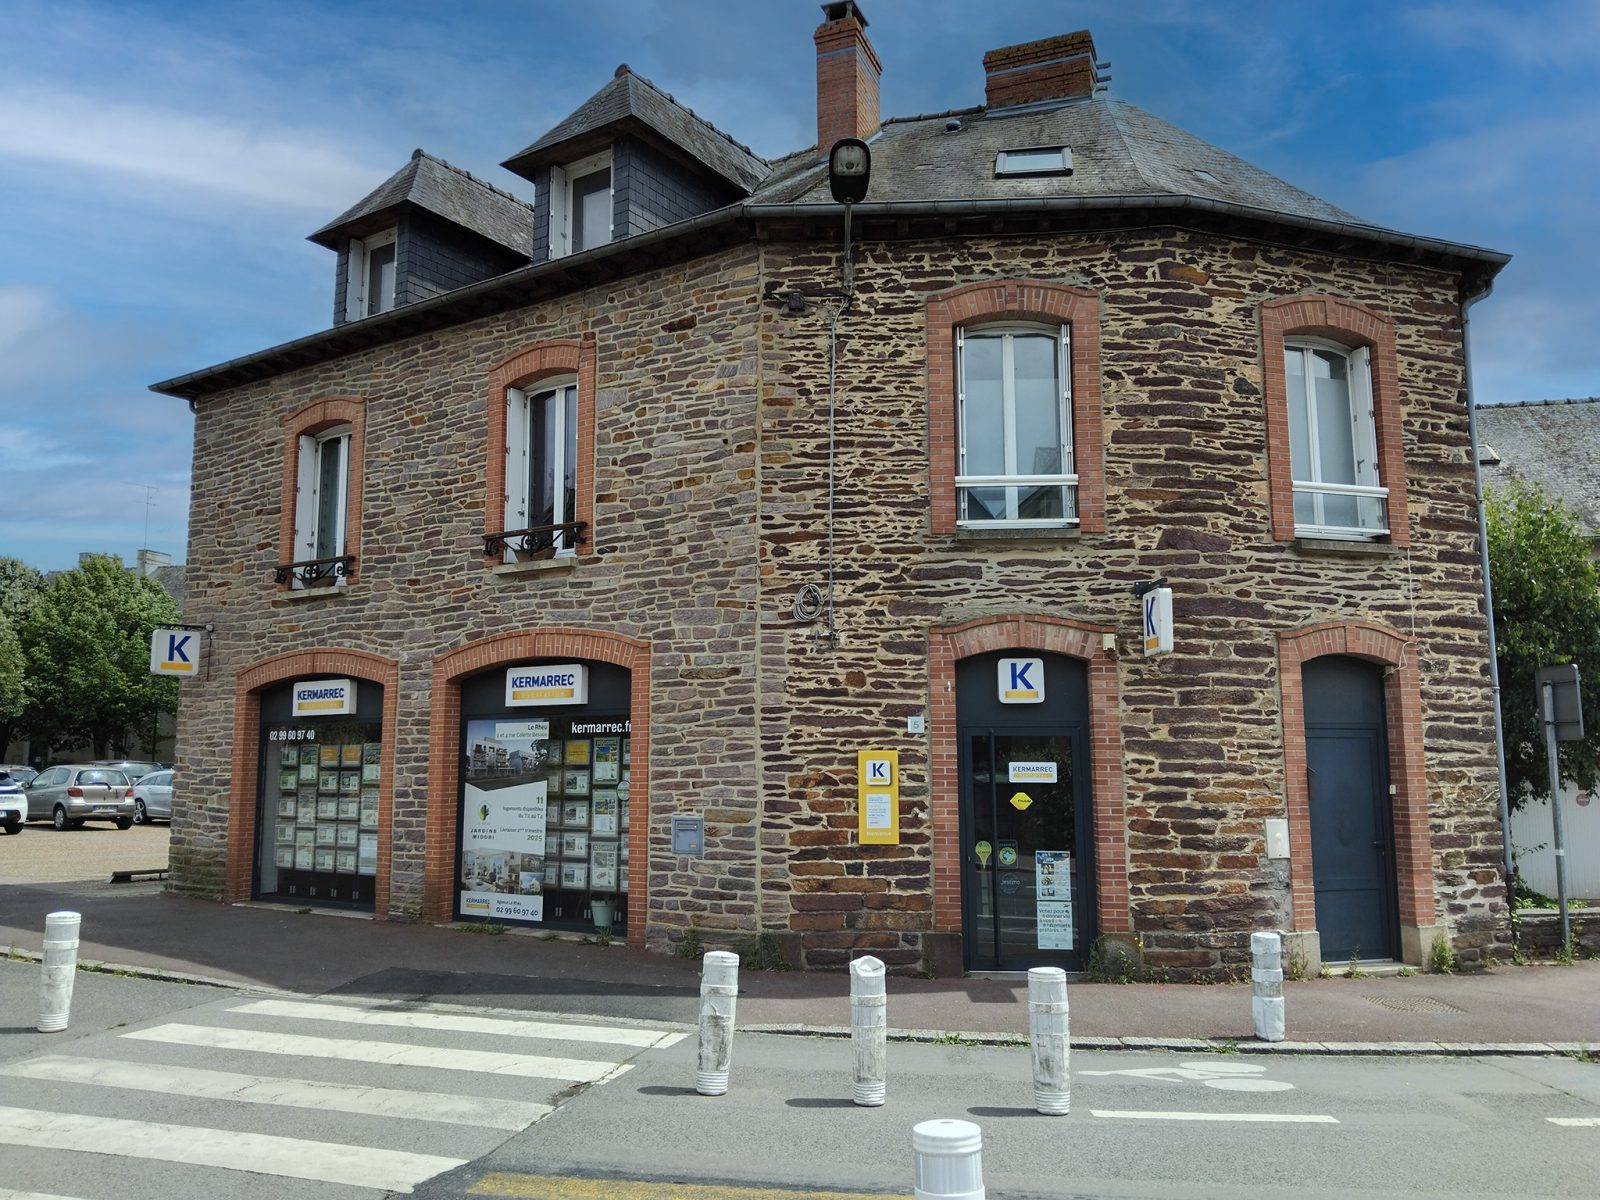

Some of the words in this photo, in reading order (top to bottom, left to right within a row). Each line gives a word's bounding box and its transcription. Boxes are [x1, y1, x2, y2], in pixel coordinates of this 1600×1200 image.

[1146, 596, 1156, 637] K
[168, 634, 191, 662] K
[512, 674, 575, 688] KERMARREC
[1010, 662, 1034, 690] K
[297, 688, 344, 700] KERMARREC
[913, 721, 919, 729] 5
[269, 731, 278, 740] 02
[279, 730, 287, 740] 99
[297, 730, 305, 740] 97
[306, 729, 315, 740] 40
[872, 762, 885, 777] K
[536, 796, 544, 804] 11
[527, 834, 543, 842] 2025
[504, 907, 512, 915] 99
[513, 906, 521, 915] 60
[522, 908, 530, 916] 97
